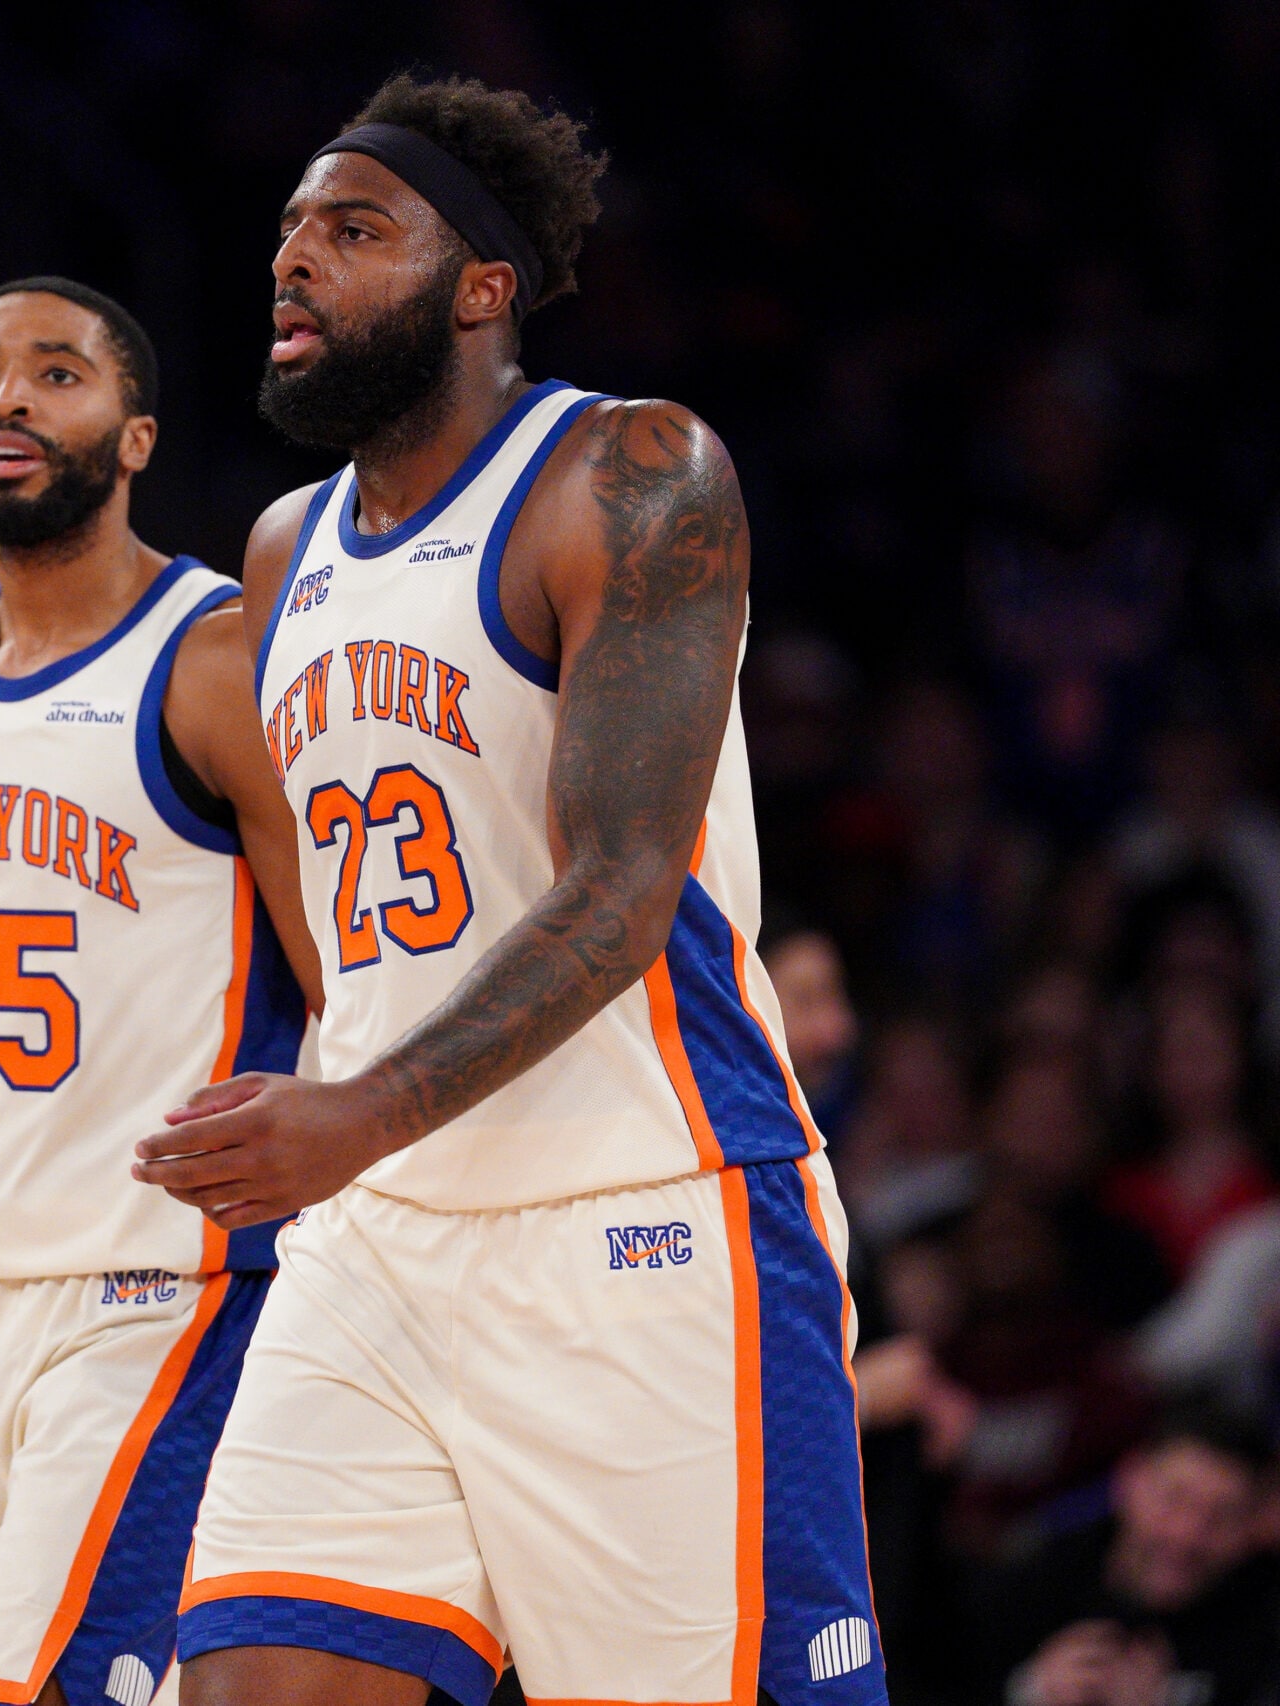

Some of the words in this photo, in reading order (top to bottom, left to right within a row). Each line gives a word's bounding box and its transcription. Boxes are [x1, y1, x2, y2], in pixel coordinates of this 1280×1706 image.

[409, 548, 436, 563] abu
[437, 541, 476, 560] dhabi
[287, 564, 333, 617] NYC
[46, 709, 75, 722] abu
[78, 709, 124, 724] dhabi
[266, 649, 333, 788] NEW
[345, 640, 480, 758] YORK
[305, 763, 474, 973] 23
[606, 1222, 693, 1270] NYC
[101, 1268, 180, 1304] NYC
